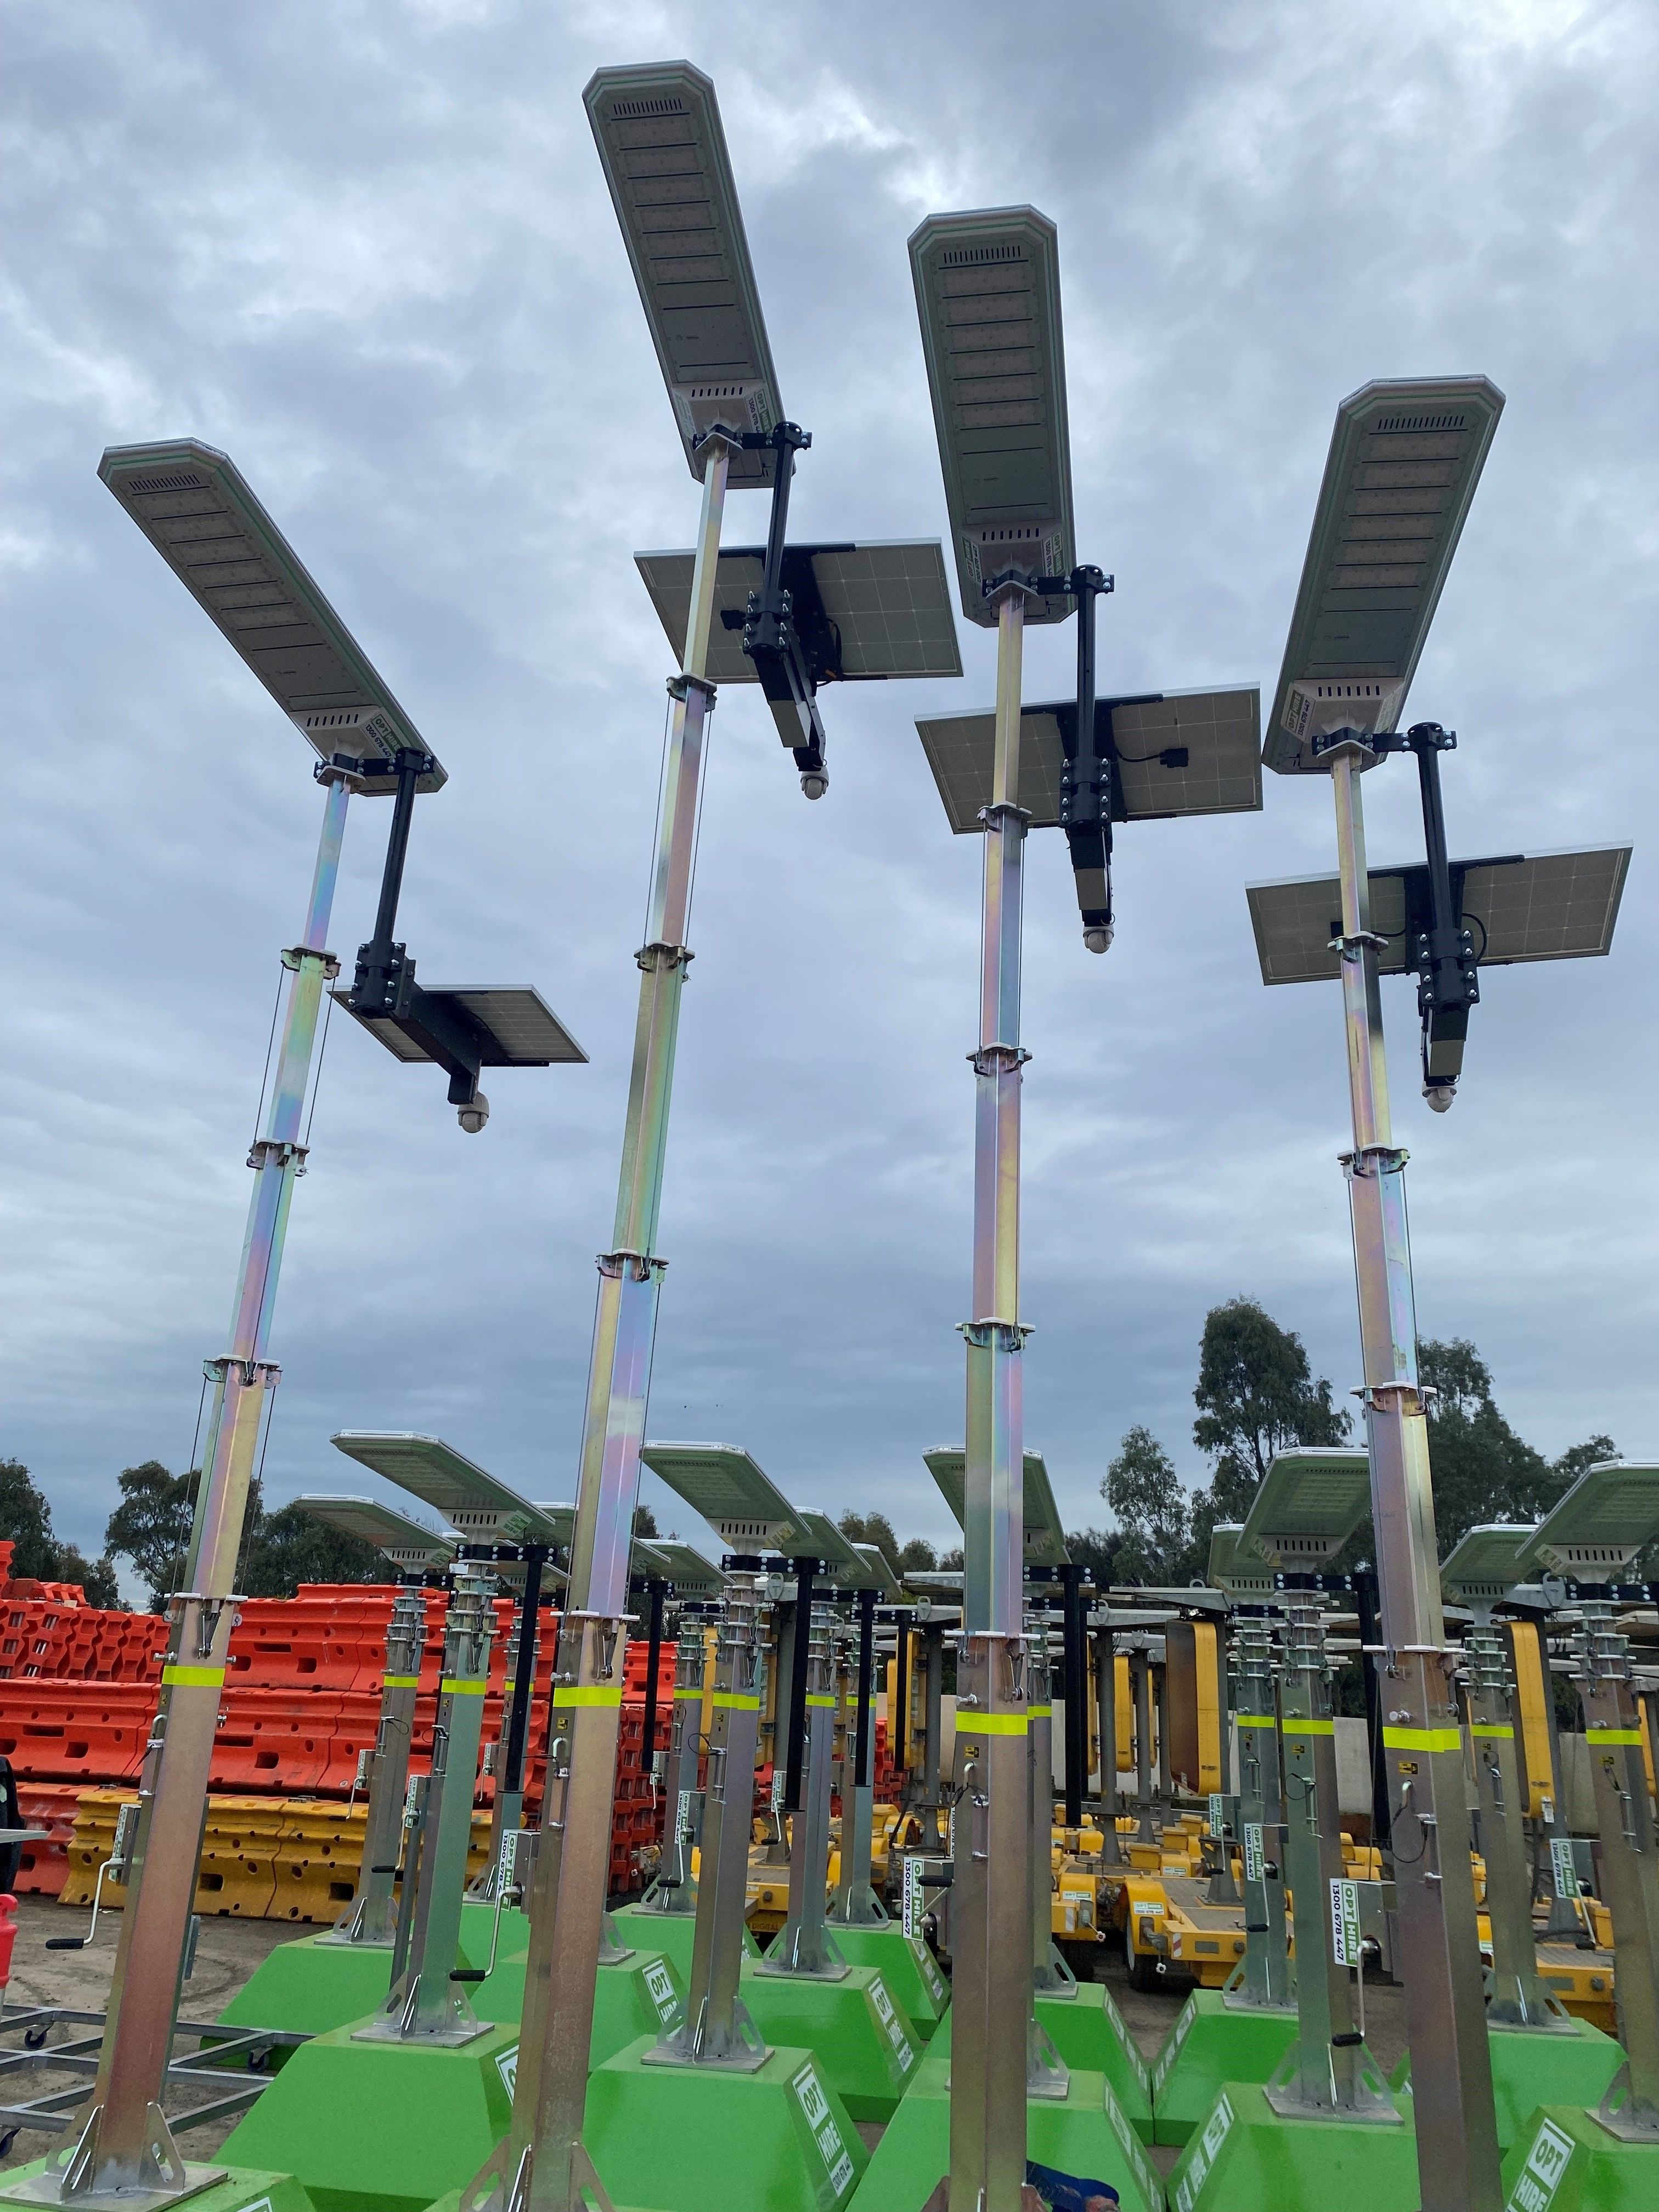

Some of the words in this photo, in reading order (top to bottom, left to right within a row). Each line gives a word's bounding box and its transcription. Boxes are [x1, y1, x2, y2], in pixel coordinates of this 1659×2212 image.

[757, 393, 765, 410] OPT
[365, 724, 377, 738] 1300
[374, 737, 384, 748] 678
[382, 748, 392, 758] 447
[375, 718, 388, 733] OPT
[1562, 1844, 1570, 1865] OPT
[1345, 1887, 1355, 1919] OPT
[1347, 1923, 1358, 1961] HIRE
[651, 1972, 669, 1997] OPT
[803, 2081, 823, 2119] OPT
[818, 2120, 842, 2164] HIRE
[1536, 2139, 1564, 2177] OPT
